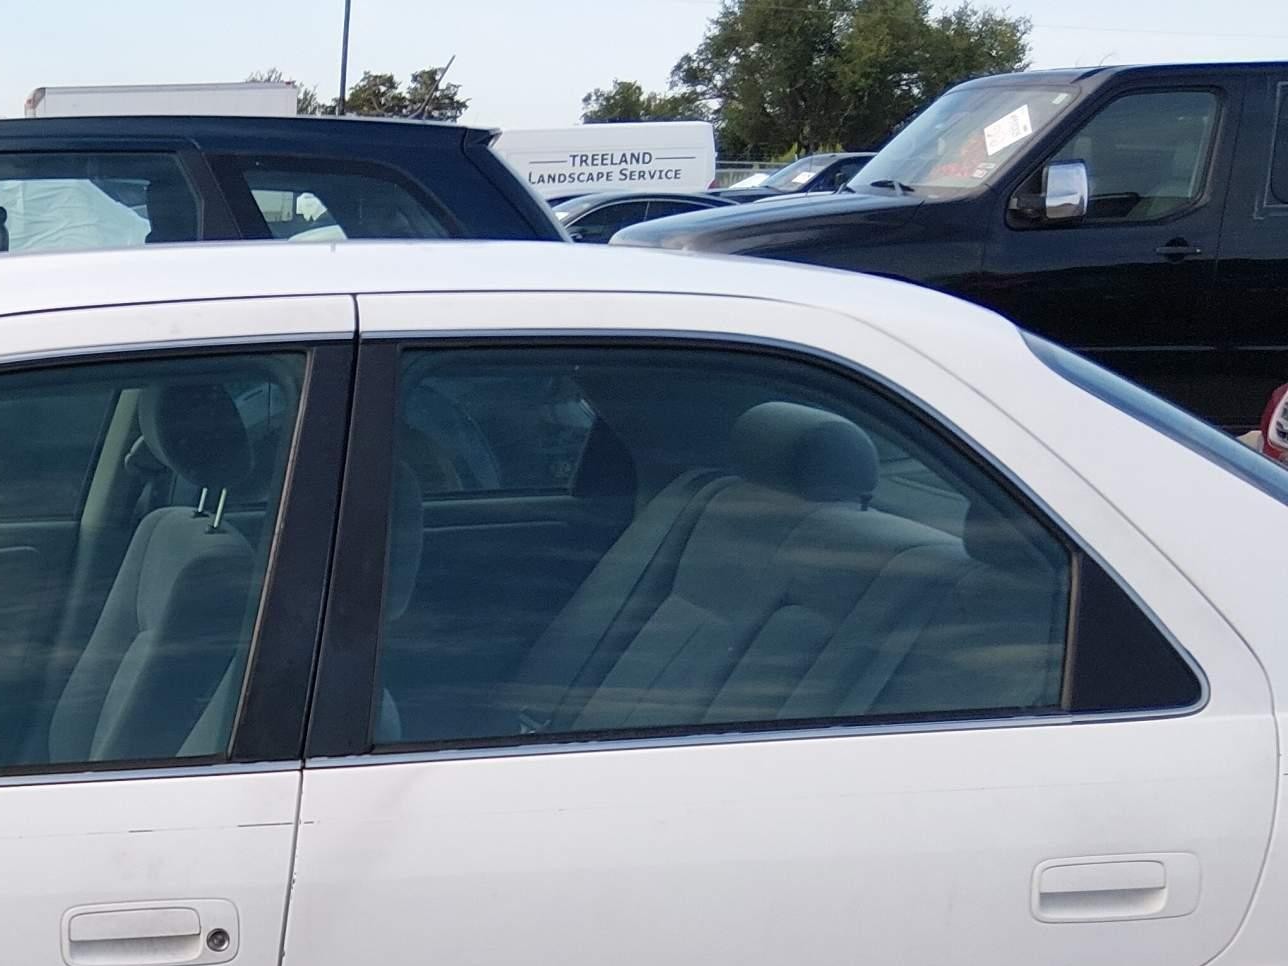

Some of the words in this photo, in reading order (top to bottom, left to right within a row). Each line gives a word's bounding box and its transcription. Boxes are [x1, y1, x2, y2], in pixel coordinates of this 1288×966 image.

[569, 152, 652, 167] TREELAND
[528, 170, 614, 184] LANDSCAPE
[618, 168, 682, 182] SERVICE
